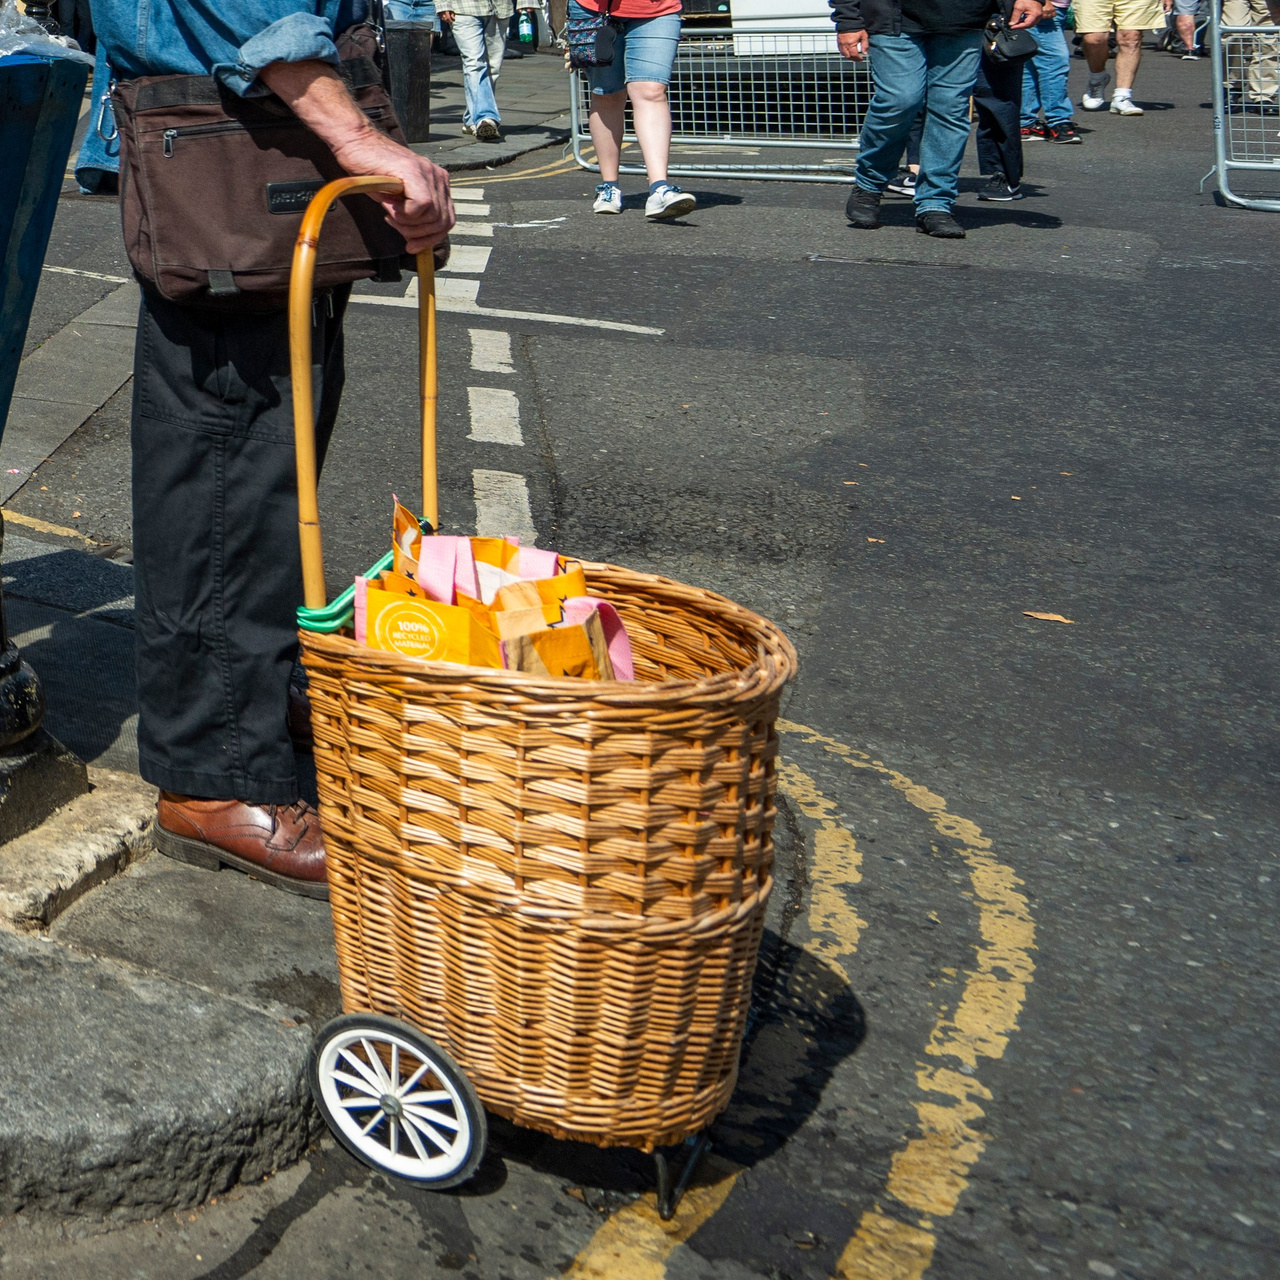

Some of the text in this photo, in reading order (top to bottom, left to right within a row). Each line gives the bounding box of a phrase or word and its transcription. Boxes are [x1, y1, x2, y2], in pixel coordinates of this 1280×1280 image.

[397, 620, 430, 634] 100%
[392, 631, 431, 642] RECYCLED
[394, 640, 431, 650] MATERIAL
